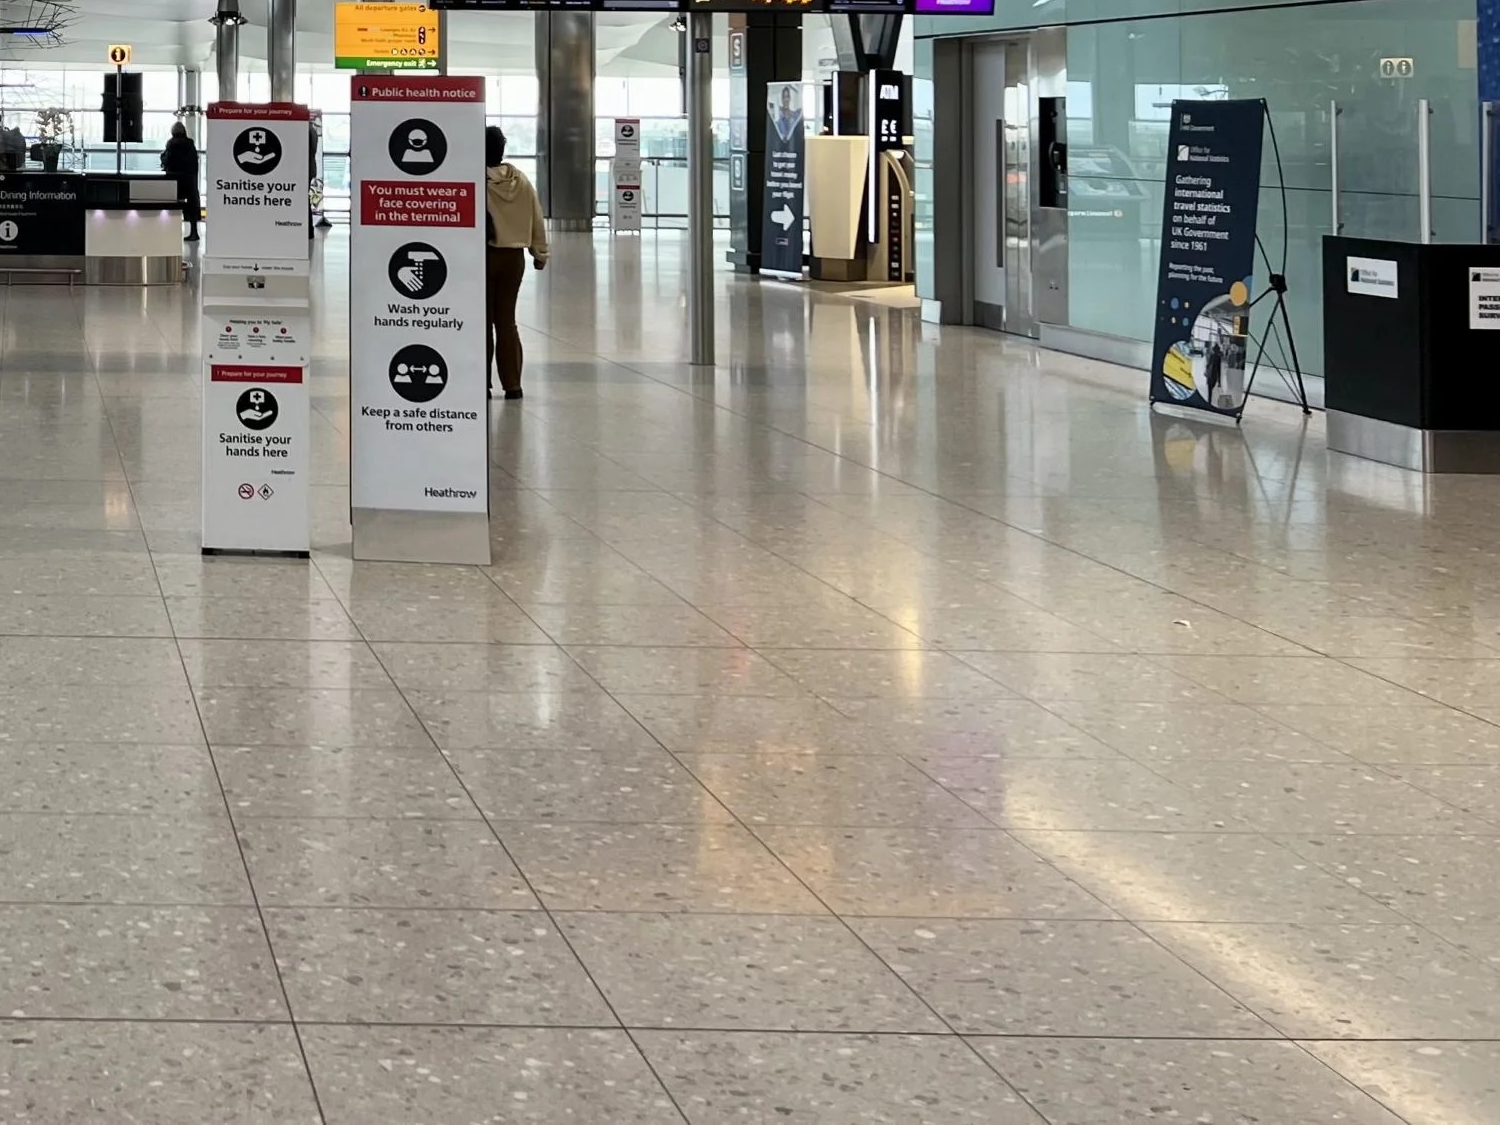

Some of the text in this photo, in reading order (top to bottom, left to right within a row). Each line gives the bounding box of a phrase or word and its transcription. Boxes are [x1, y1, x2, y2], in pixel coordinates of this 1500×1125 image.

[372, 88, 476, 98] Public health notice
[219, 108, 242, 116] Prepare
[216, 179, 297, 194] Sanitise your
[1175, 175, 1212, 188] Gathering
[0, 191, 27, 202] Dining
[29, 191, 77, 200] Information
[369, 185, 467, 197] You must wear a
[1175, 188, 1224, 199] international
[223, 194, 292, 206] hands here
[379, 197, 457, 211] face covering
[1174, 202, 1231, 213] travel statistics
[375, 211, 461, 223] in the terminal
[1184, 215, 1207, 225] behalf
[1208, 216, 1216, 225] of
[1172, 227, 1229, 240] UK Government
[1171, 239, 1208, 251] since 1961
[387, 304, 450, 318] Wash your
[374, 316, 464, 331] hands regularly
[362, 406, 478, 420] Keep a safe distance
[385, 420, 453, 432] from others
[219, 433, 292, 447] Sanitise your
[225, 445, 288, 458] hands here
[424, 487, 477, 499] Heathrow
